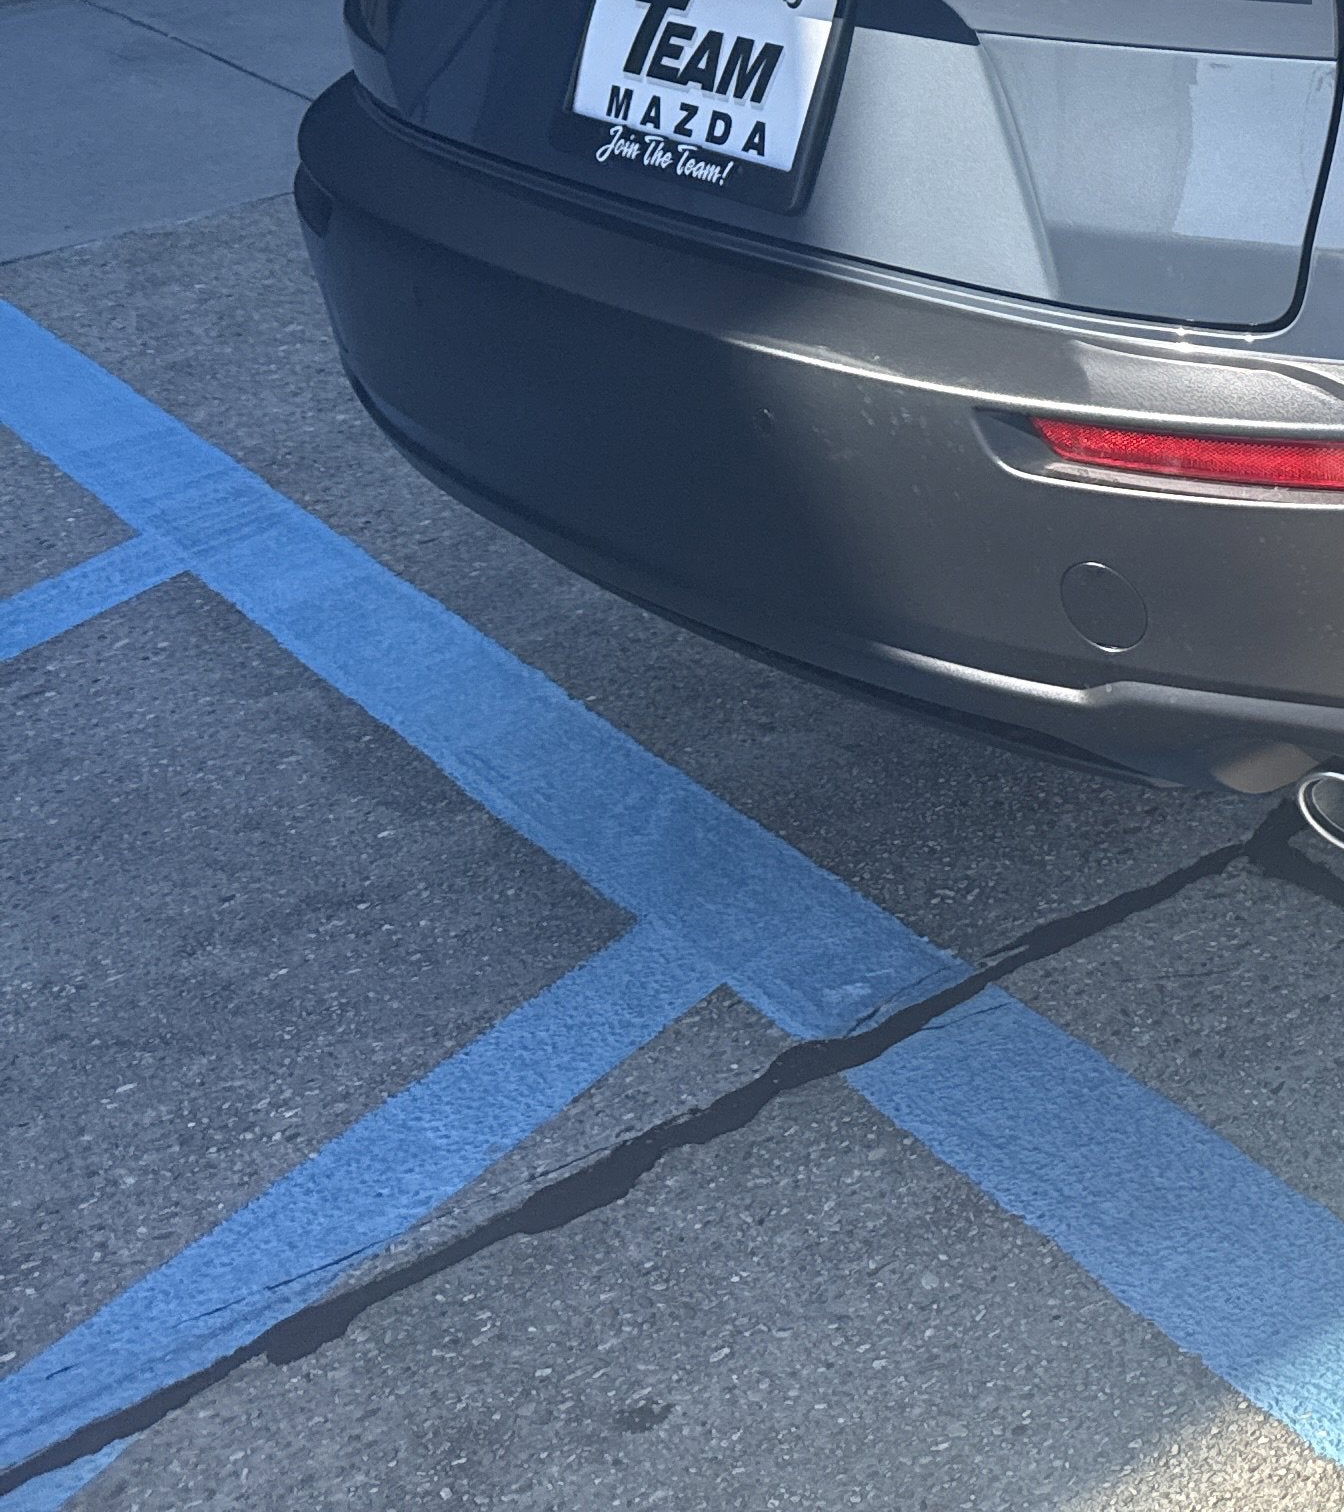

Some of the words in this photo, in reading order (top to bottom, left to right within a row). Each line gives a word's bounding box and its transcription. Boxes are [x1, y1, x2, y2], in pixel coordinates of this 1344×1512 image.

[605, 85, 768, 158] MAZDA
[596, 126, 642, 162] Join
[641, 135, 675, 169] The
[676, 144, 735, 186] Team!
